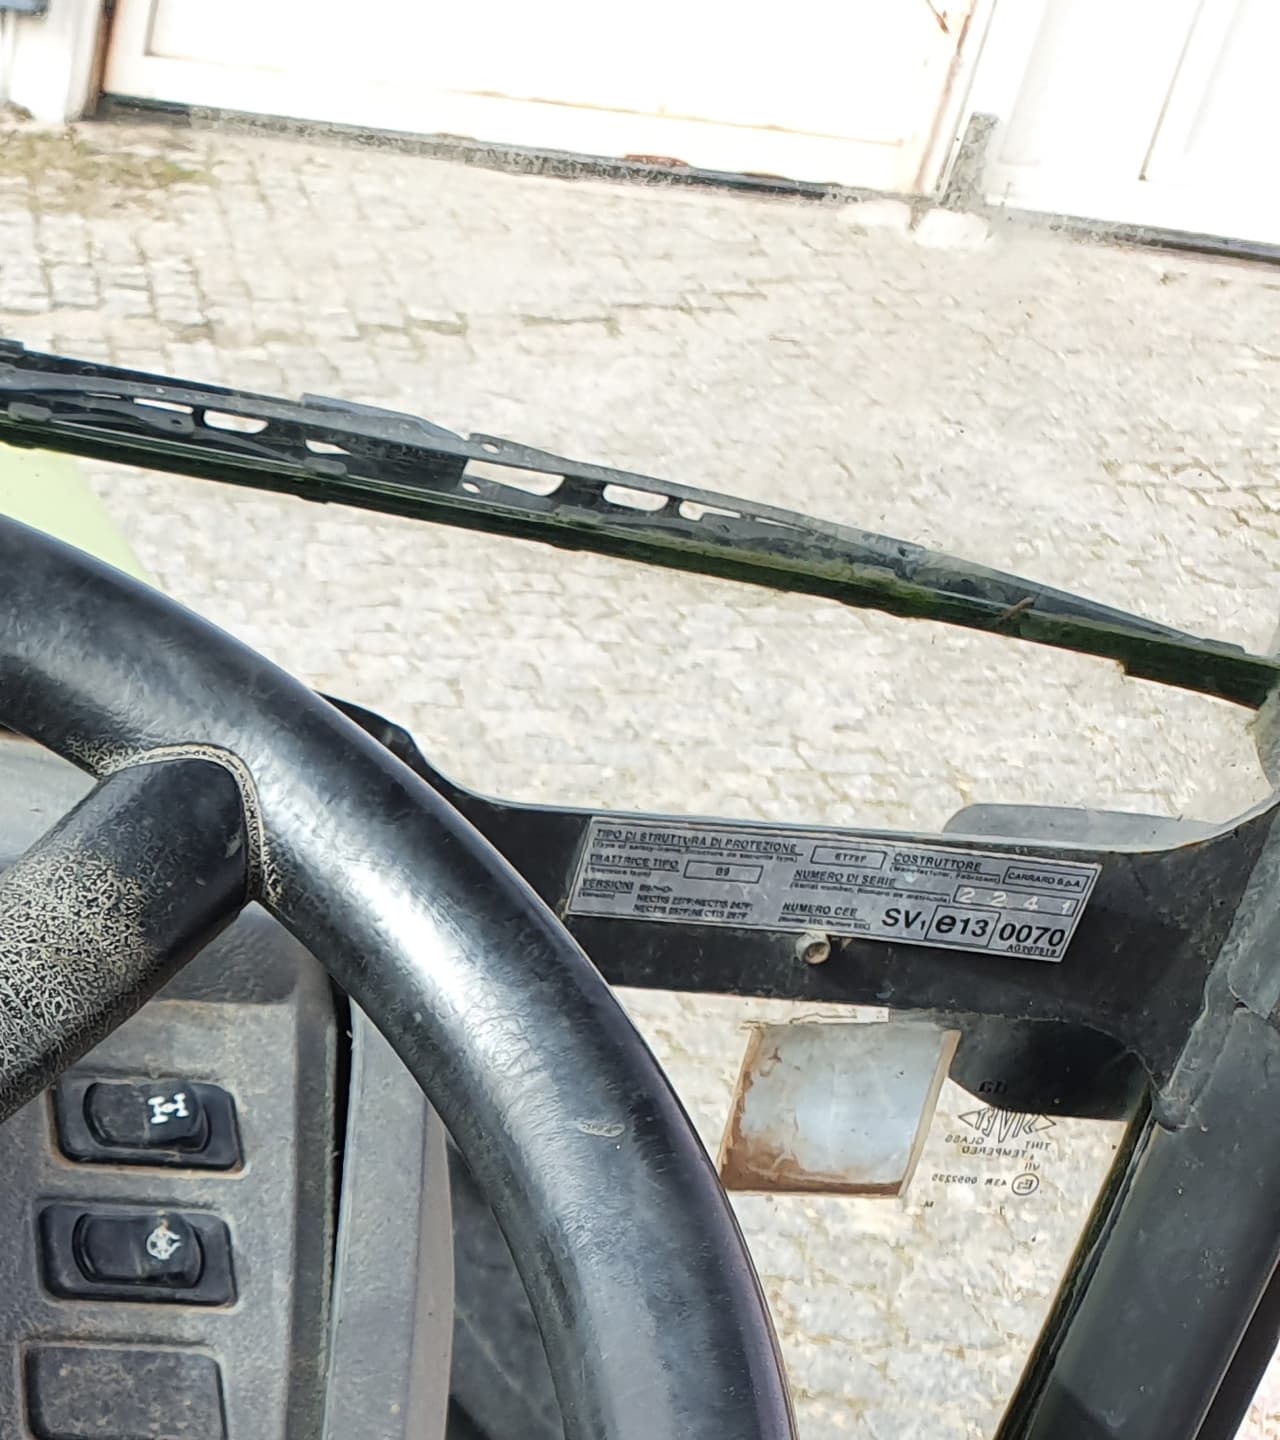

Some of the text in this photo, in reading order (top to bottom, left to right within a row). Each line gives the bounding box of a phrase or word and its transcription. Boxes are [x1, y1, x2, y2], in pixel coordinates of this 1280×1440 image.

[597, 828, 798, 854] TIPO DI STRUTTURA DI PROTEZIONE
[590, 854, 680, 869] TRATTRICE TIPO
[893, 852, 982, 872] COSTRUTTORE
[583, 878, 635, 891] VERSIONI
[794, 869, 897, 888] NUMERO DI SERIE
[1007, 872, 1056, 885] CARRARO
[782, 902, 859, 917] NUMERO CEE
[935, 914, 989, 938] e13
[999, 922, 1066, 948] 0070
